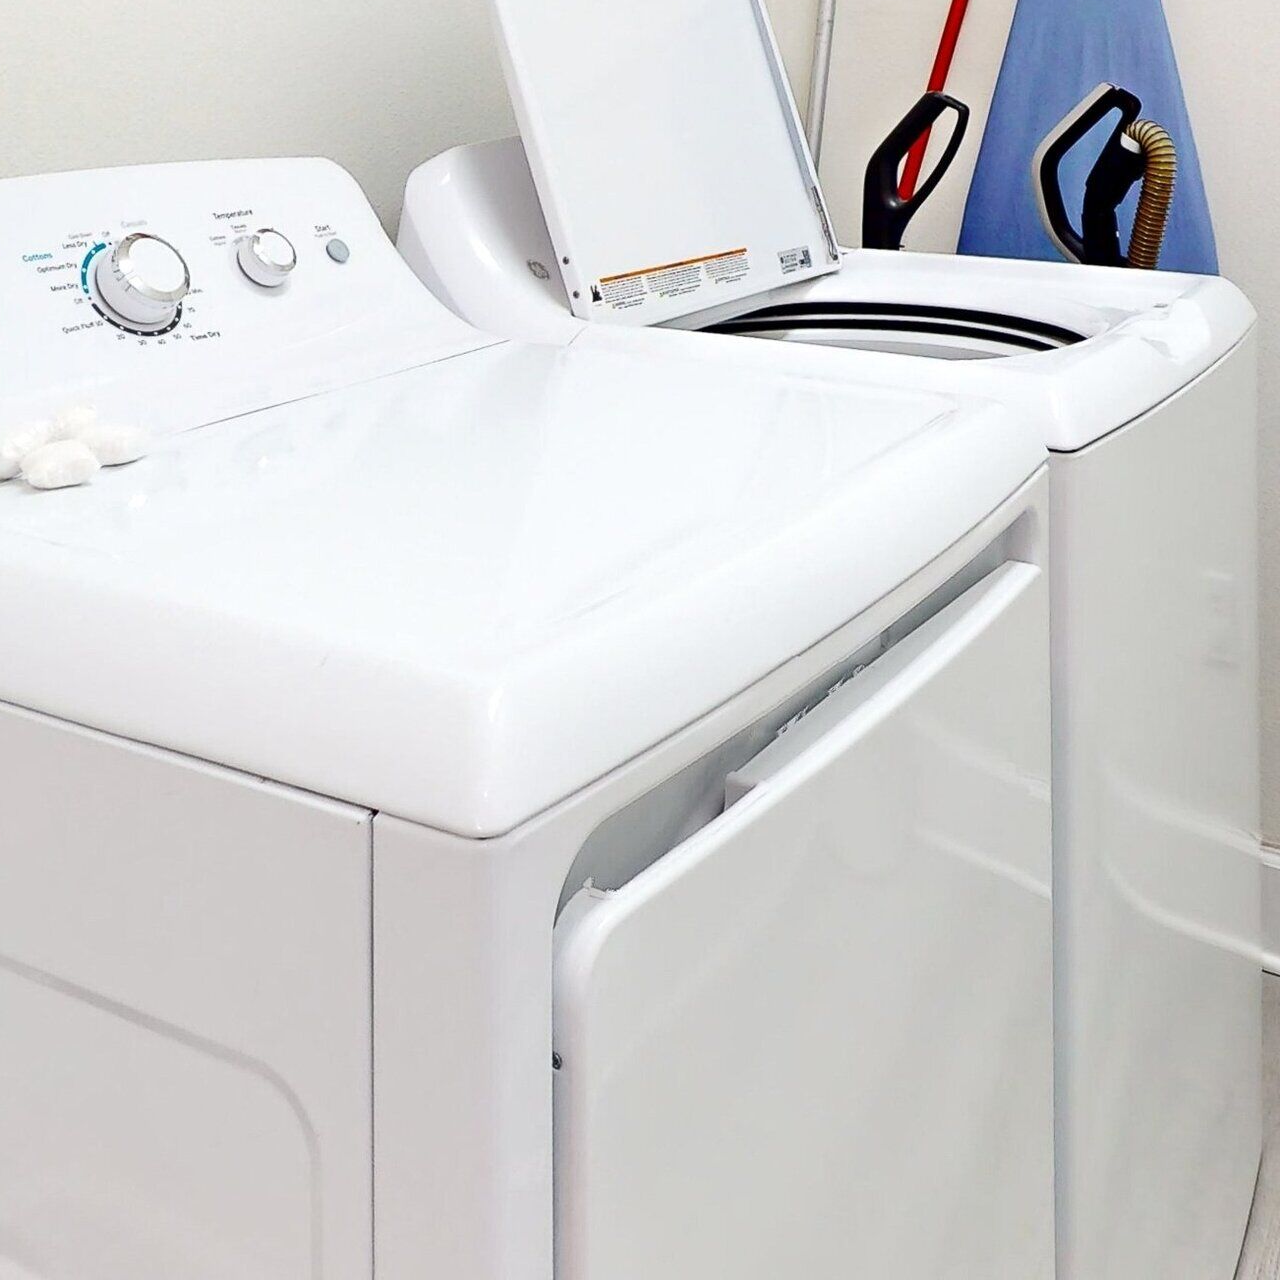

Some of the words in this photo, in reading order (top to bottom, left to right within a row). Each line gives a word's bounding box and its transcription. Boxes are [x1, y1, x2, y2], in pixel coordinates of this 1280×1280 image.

[22, 251, 54, 263] Cottons
[190, 333, 207, 342] Time
[208, 330, 222, 341] Dry
